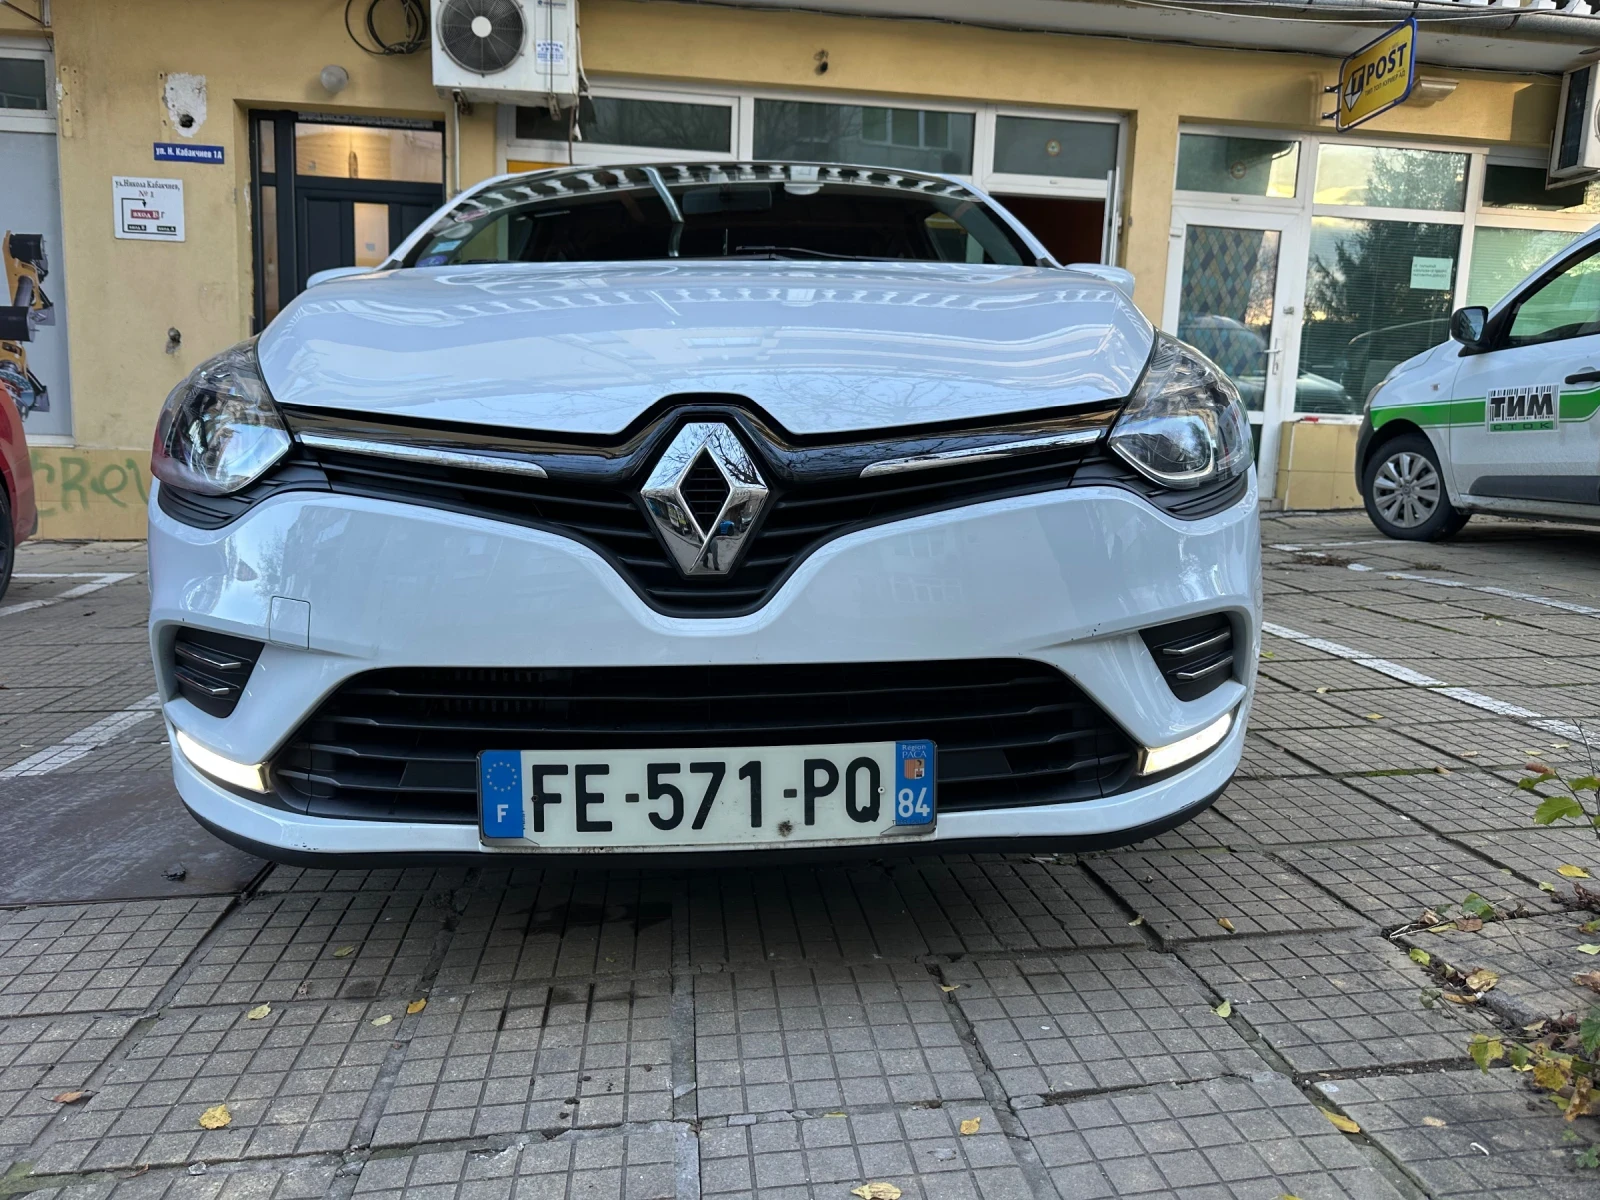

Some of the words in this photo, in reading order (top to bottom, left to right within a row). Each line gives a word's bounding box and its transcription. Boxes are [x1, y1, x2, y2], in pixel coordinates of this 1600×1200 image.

[1366, 42, 1407, 86] POST
[156, 147, 166, 155] ул.
[167, 147, 175, 155] Н.
[175, 147, 212, 158] Кабакчиев
[1490, 393, 1553, 418] ТИМ
[1493, 422, 1550, 431] СТОК
[902, 744, 926, 752] Région
[902, 751, 927, 759] PACA
[898, 787, 931, 818] 84
[497, 804, 509, 823] F
